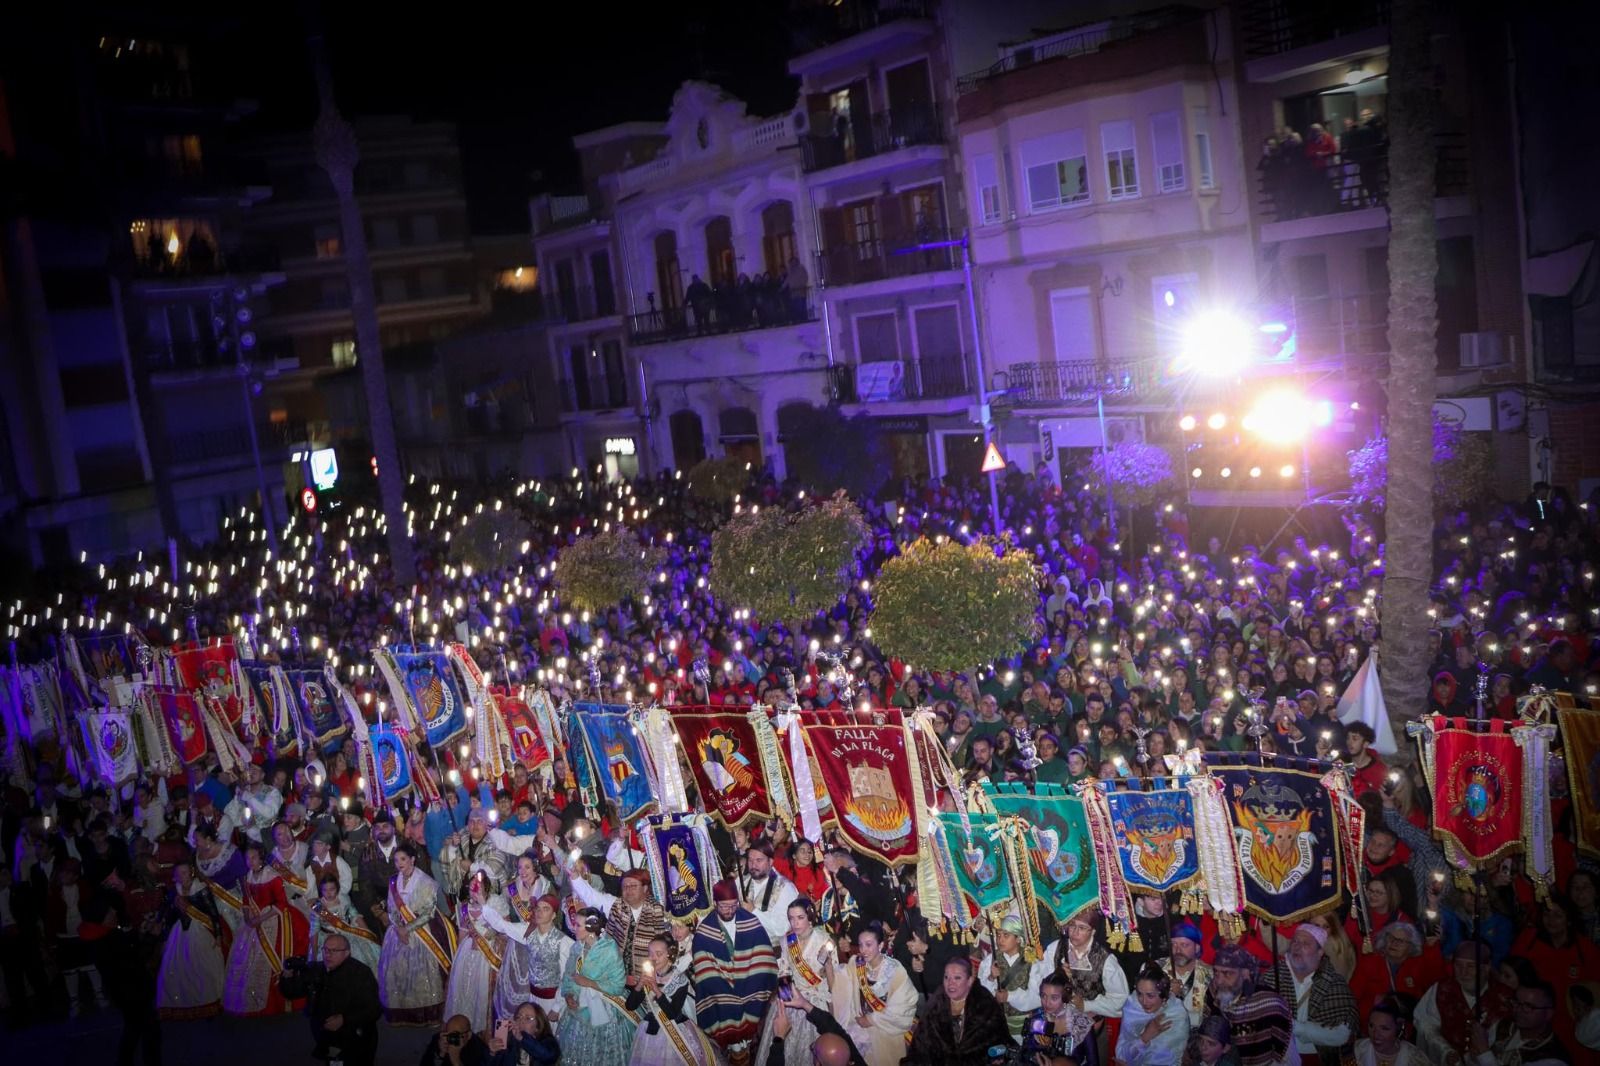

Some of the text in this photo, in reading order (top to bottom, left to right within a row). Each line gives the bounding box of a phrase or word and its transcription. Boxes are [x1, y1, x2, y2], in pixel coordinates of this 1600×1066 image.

[834, 729, 879, 741] FALLA
[831, 747, 844, 758] DE
[841, 742, 859, 751] LA
